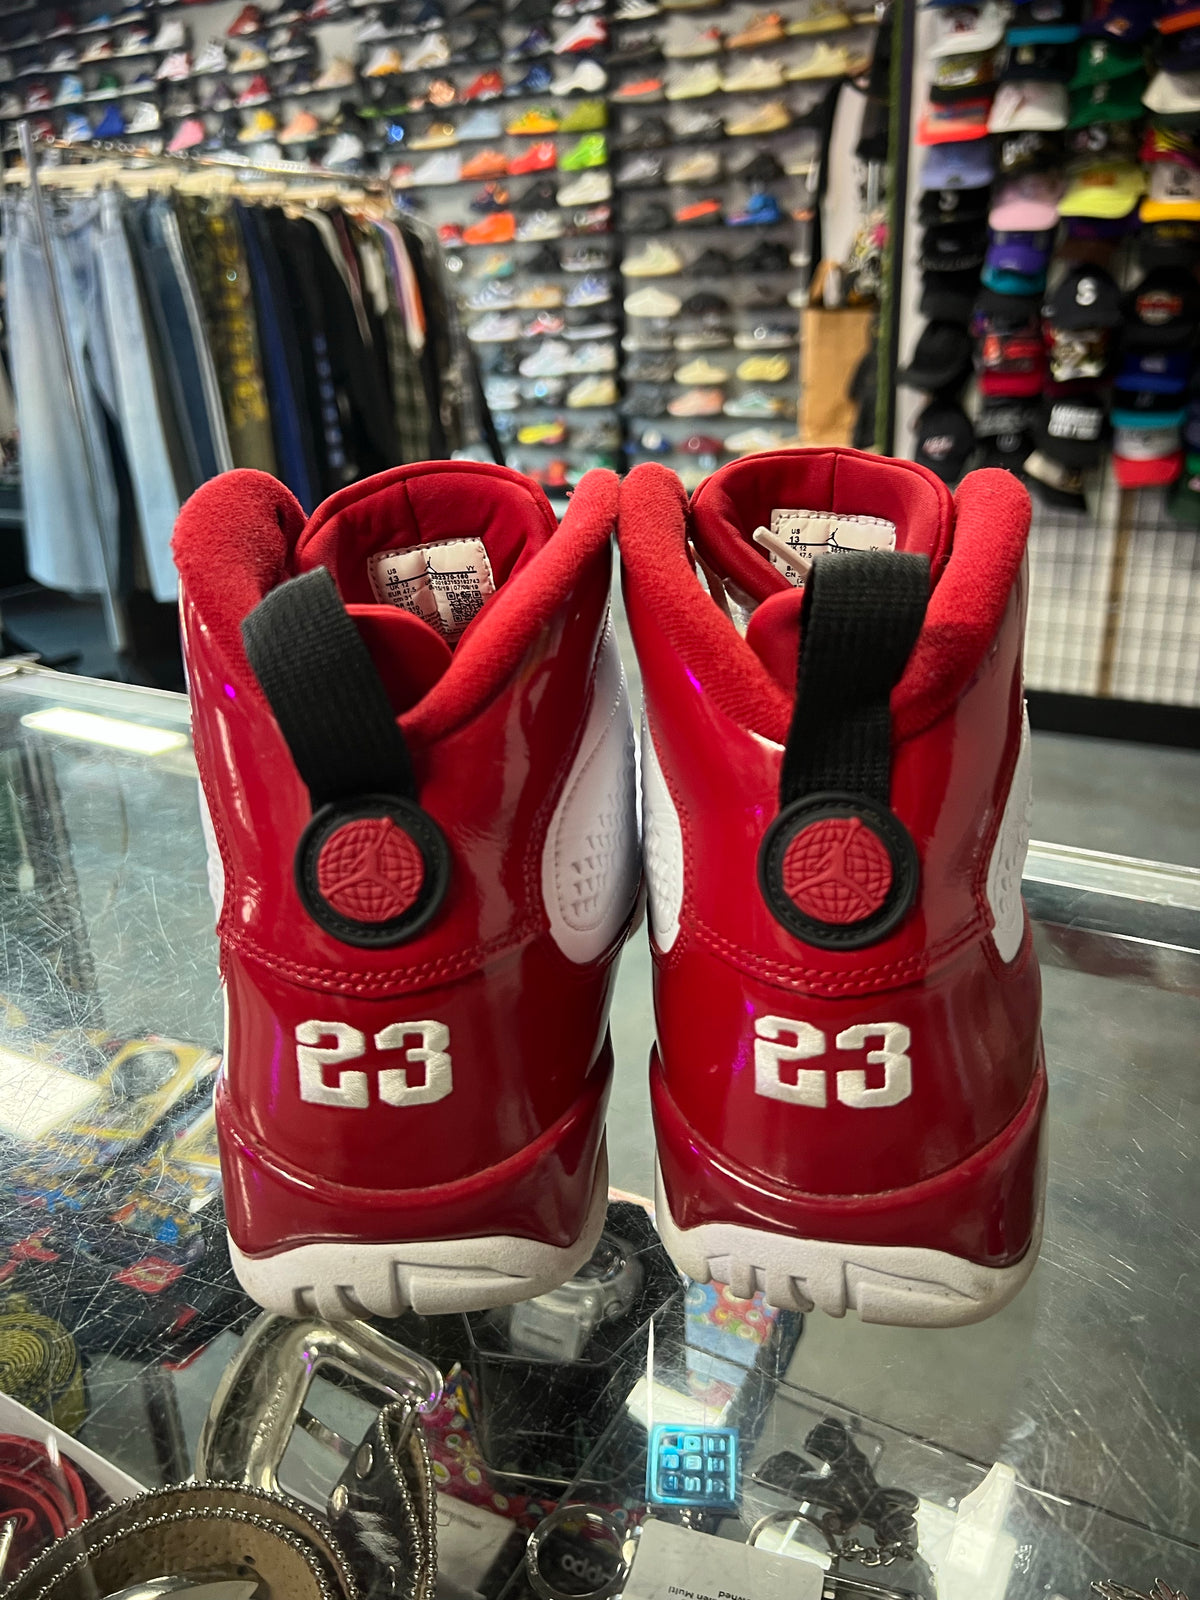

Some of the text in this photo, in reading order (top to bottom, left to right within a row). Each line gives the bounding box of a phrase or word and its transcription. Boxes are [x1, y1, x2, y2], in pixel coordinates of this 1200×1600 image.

[388, 590, 402, 598] EUR
[294, 1018, 454, 1110] 23
[754, 1014, 912, 1110] 23
